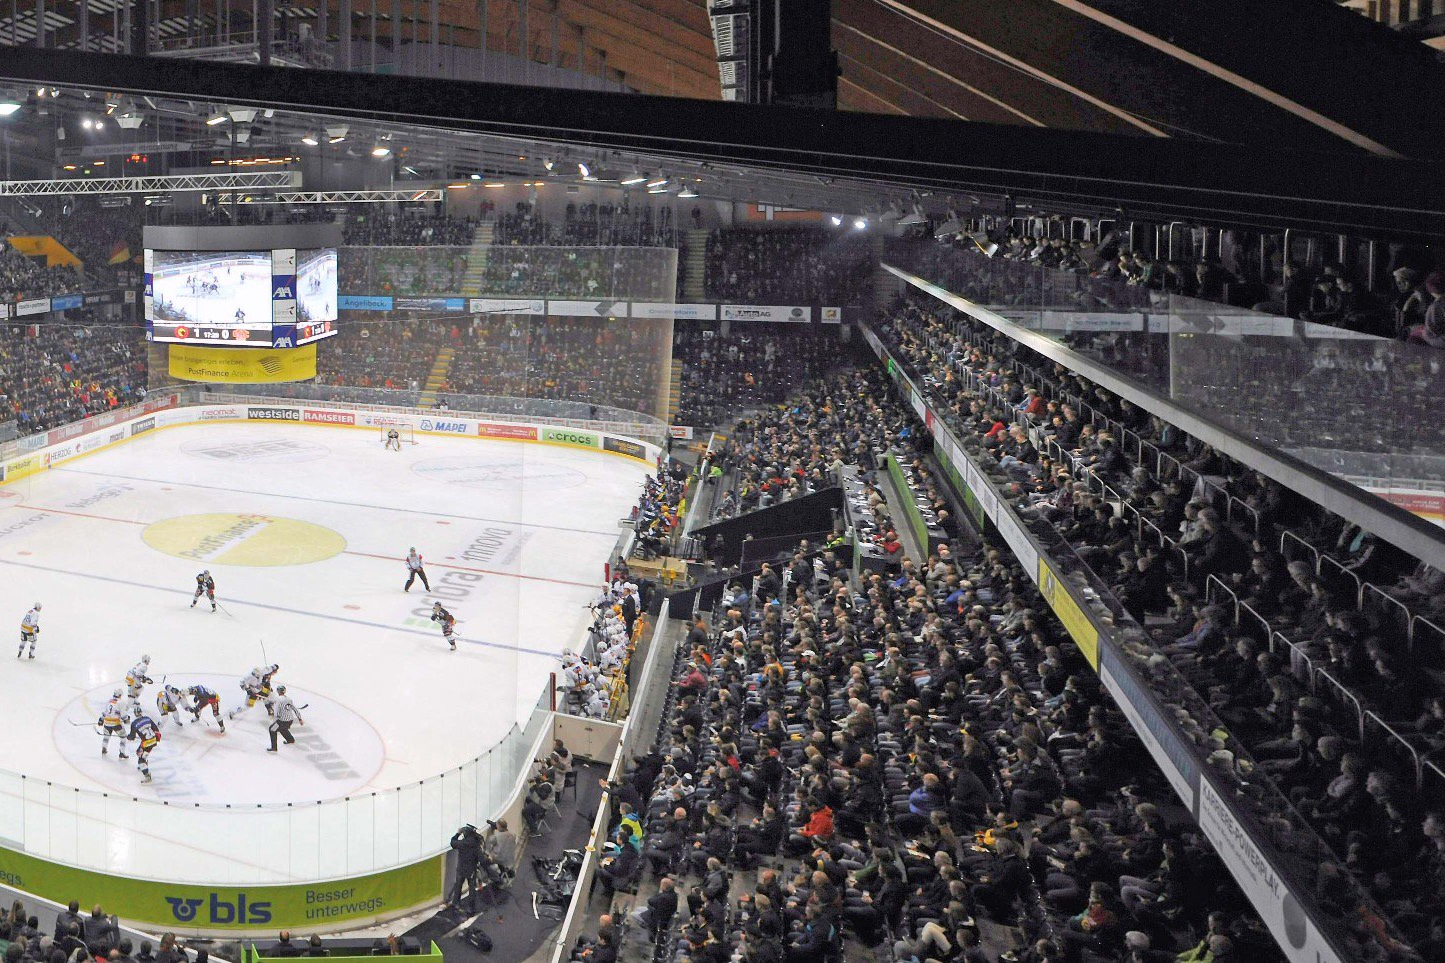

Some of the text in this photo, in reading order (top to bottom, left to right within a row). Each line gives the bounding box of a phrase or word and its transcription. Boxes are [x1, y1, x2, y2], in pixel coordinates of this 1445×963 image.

[273, 286, 292, 298] AXA
[273, 337, 292, 348] AXA
[188, 367, 253, 378] PostFinance Arena
[248, 408, 299, 419] westside
[305, 412, 354, 424] RAMSEIER
[435, 421, 467, 433] MAPEI
[556, 432, 592, 446] crocs
[50, 447, 72, 461] HERZOG
[307, 887, 356, 904] Besser
[210, 892, 272, 924] bls
[307, 896, 387, 920] unterwegs.
